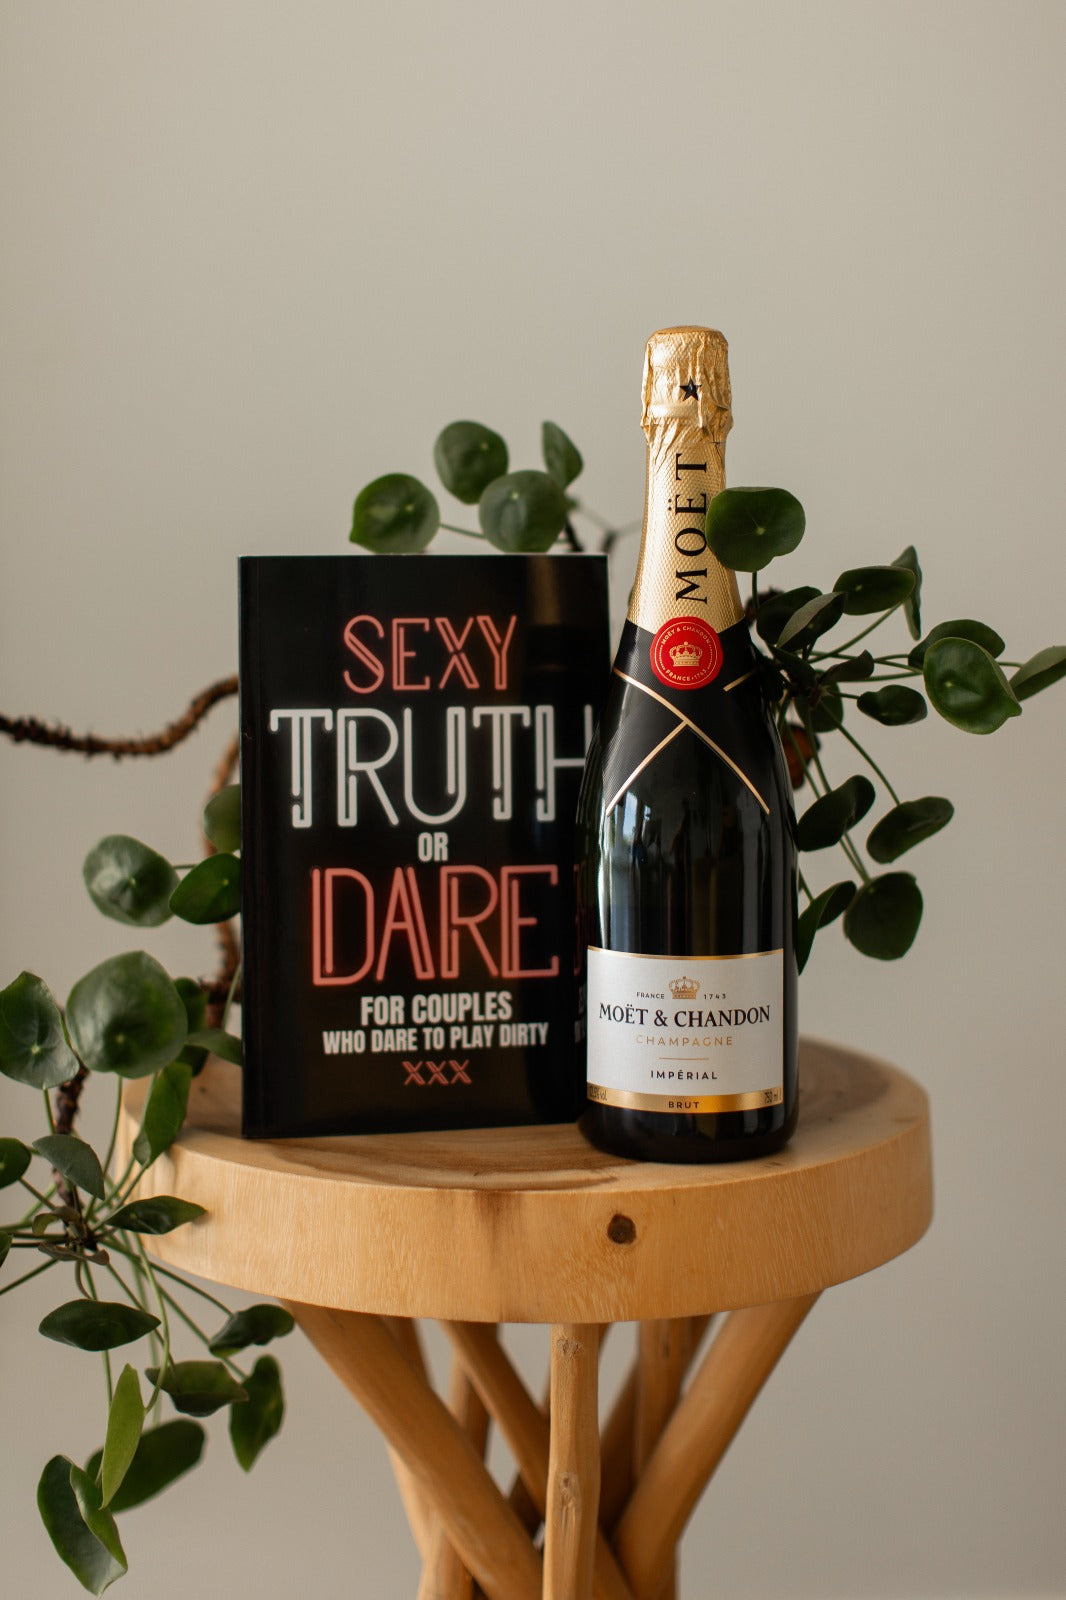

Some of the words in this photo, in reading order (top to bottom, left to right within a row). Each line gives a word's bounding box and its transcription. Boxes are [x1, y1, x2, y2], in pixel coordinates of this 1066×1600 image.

[667, 452, 707, 604] MOËT
[343, 614, 518, 694] SEXY
[665, 669, 691, 681] FRANCE
[269, 704, 593, 828] TRUTH
[417, 831, 449, 862] OR
[311, 864, 560, 987] DARE
[361, 995, 405, 1027] FOR
[411, 991, 513, 1025] COUPLES
[636, 992, 665, 1000] FRANCE
[599, 1003, 648, 1026] MOËT
[653, 1010, 668, 1027] &
[674, 1005, 771, 1028] CHANDON
[322, 1030, 366, 1055] WHO
[371, 1027, 418, 1053] DARE
[424, 1026, 445, 1051] TO
[450, 1024, 493, 1050] PLAY
[500, 1022, 549, 1048] DIRTY
[636, 1035, 733, 1047] CHAMPAGNE
[402, 1059, 473, 1086] XXX
[650, 1069, 718, 1080] IMPÉRIAL
[668, 1101, 700, 1109] BRUT
